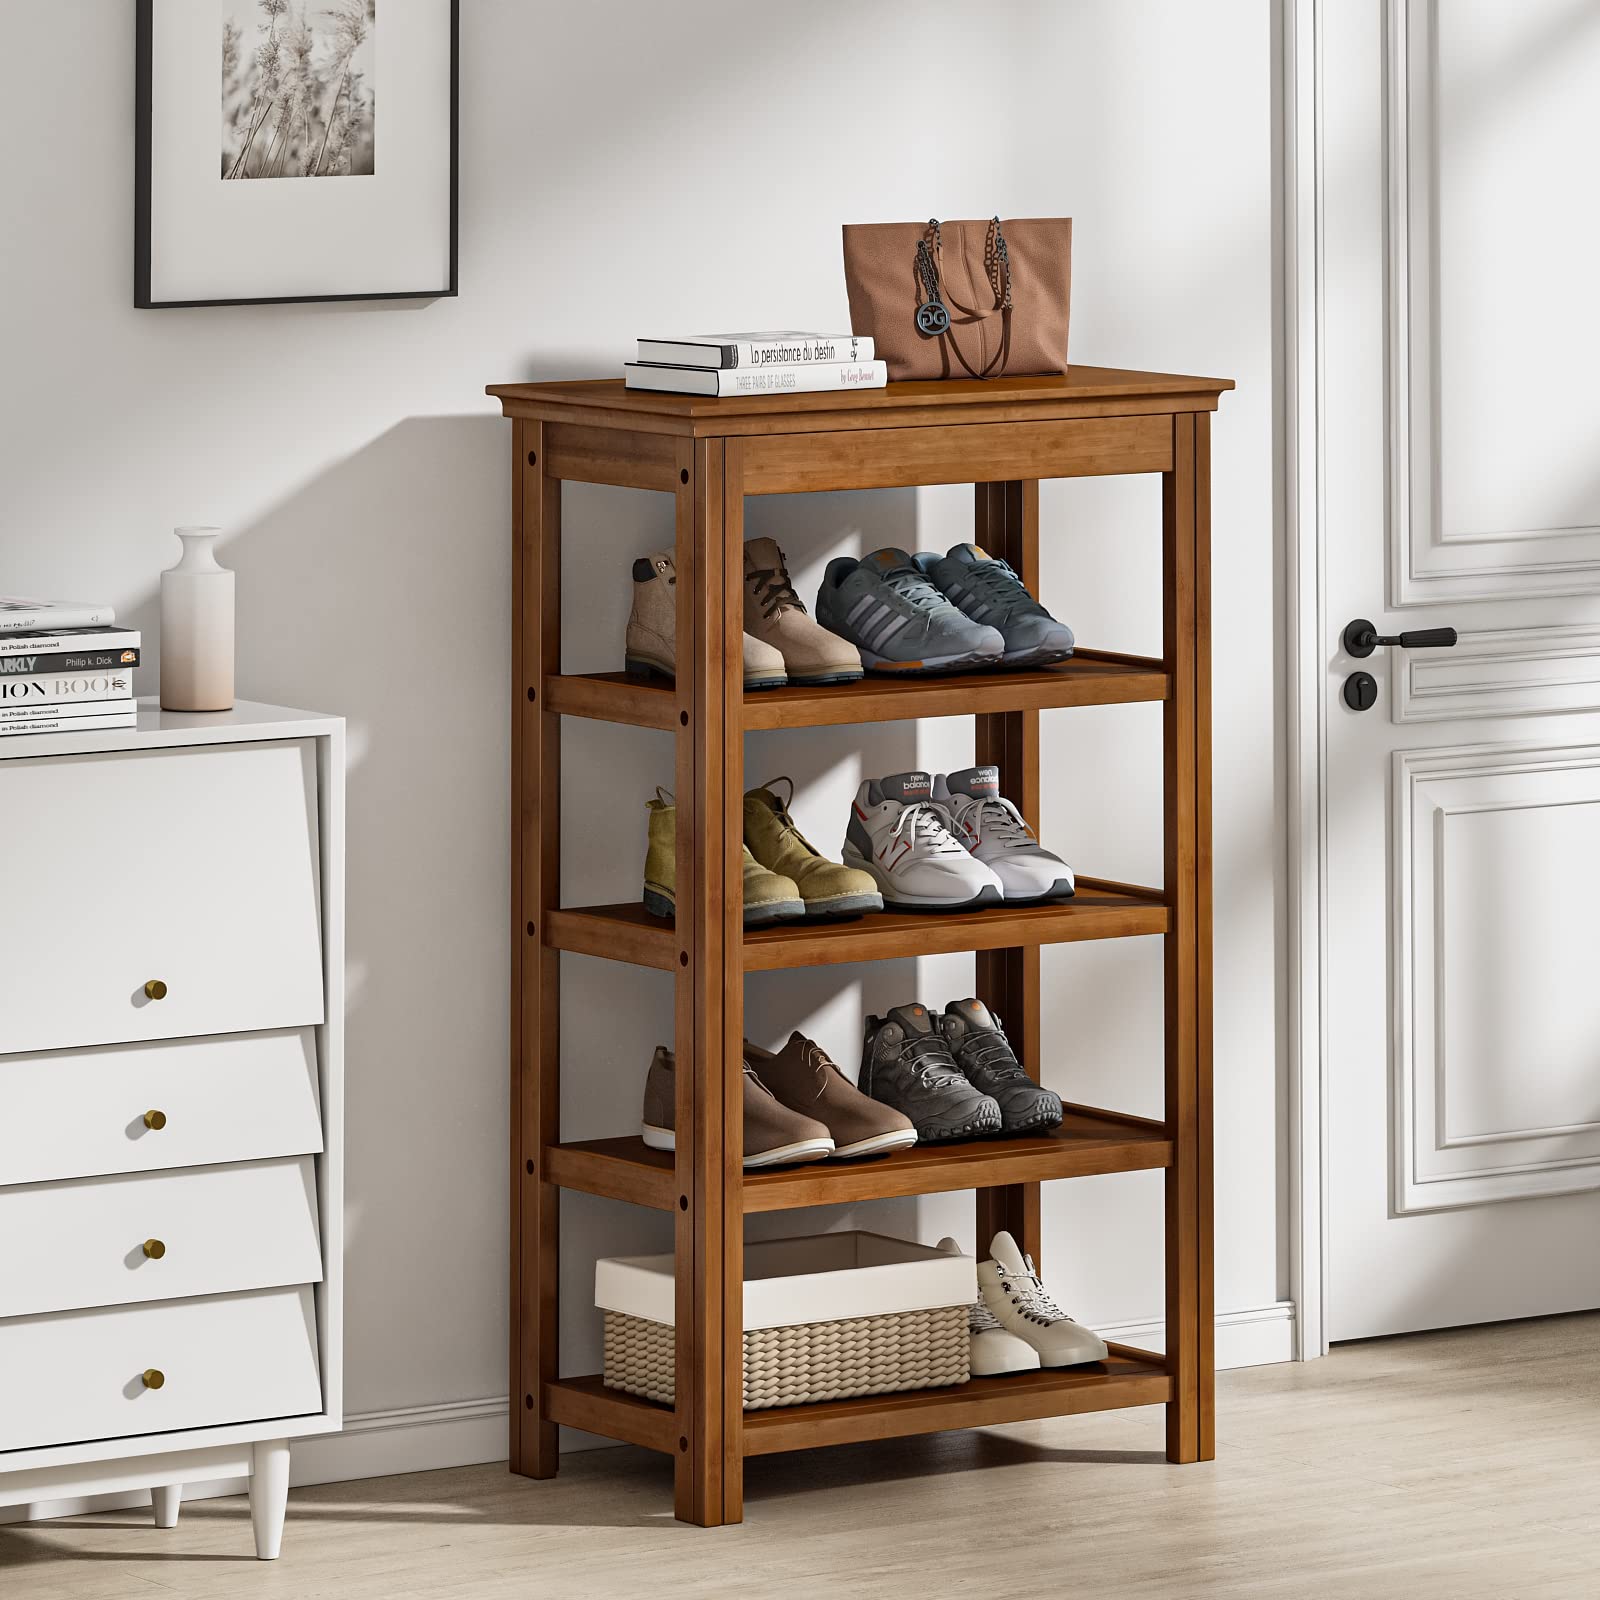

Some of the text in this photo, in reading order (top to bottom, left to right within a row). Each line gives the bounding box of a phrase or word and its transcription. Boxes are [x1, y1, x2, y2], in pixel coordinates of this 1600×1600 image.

[814, 339, 835, 361] destin
[736, 376, 751, 390] THREE
[767, 374, 774, 389] OF
[775, 373, 796, 388] GLASSES
[30, 641, 60, 649] diamond
[65, 657, 86, 667] Philip
[96, 656, 113, 665] Dick
[2, 681, 47, 699] ION
[9, 709, 29, 717] Polish
[30, 708, 59, 716] diamond
[9, 723, 29, 731] Polish
[30, 722, 59, 730] diamond
